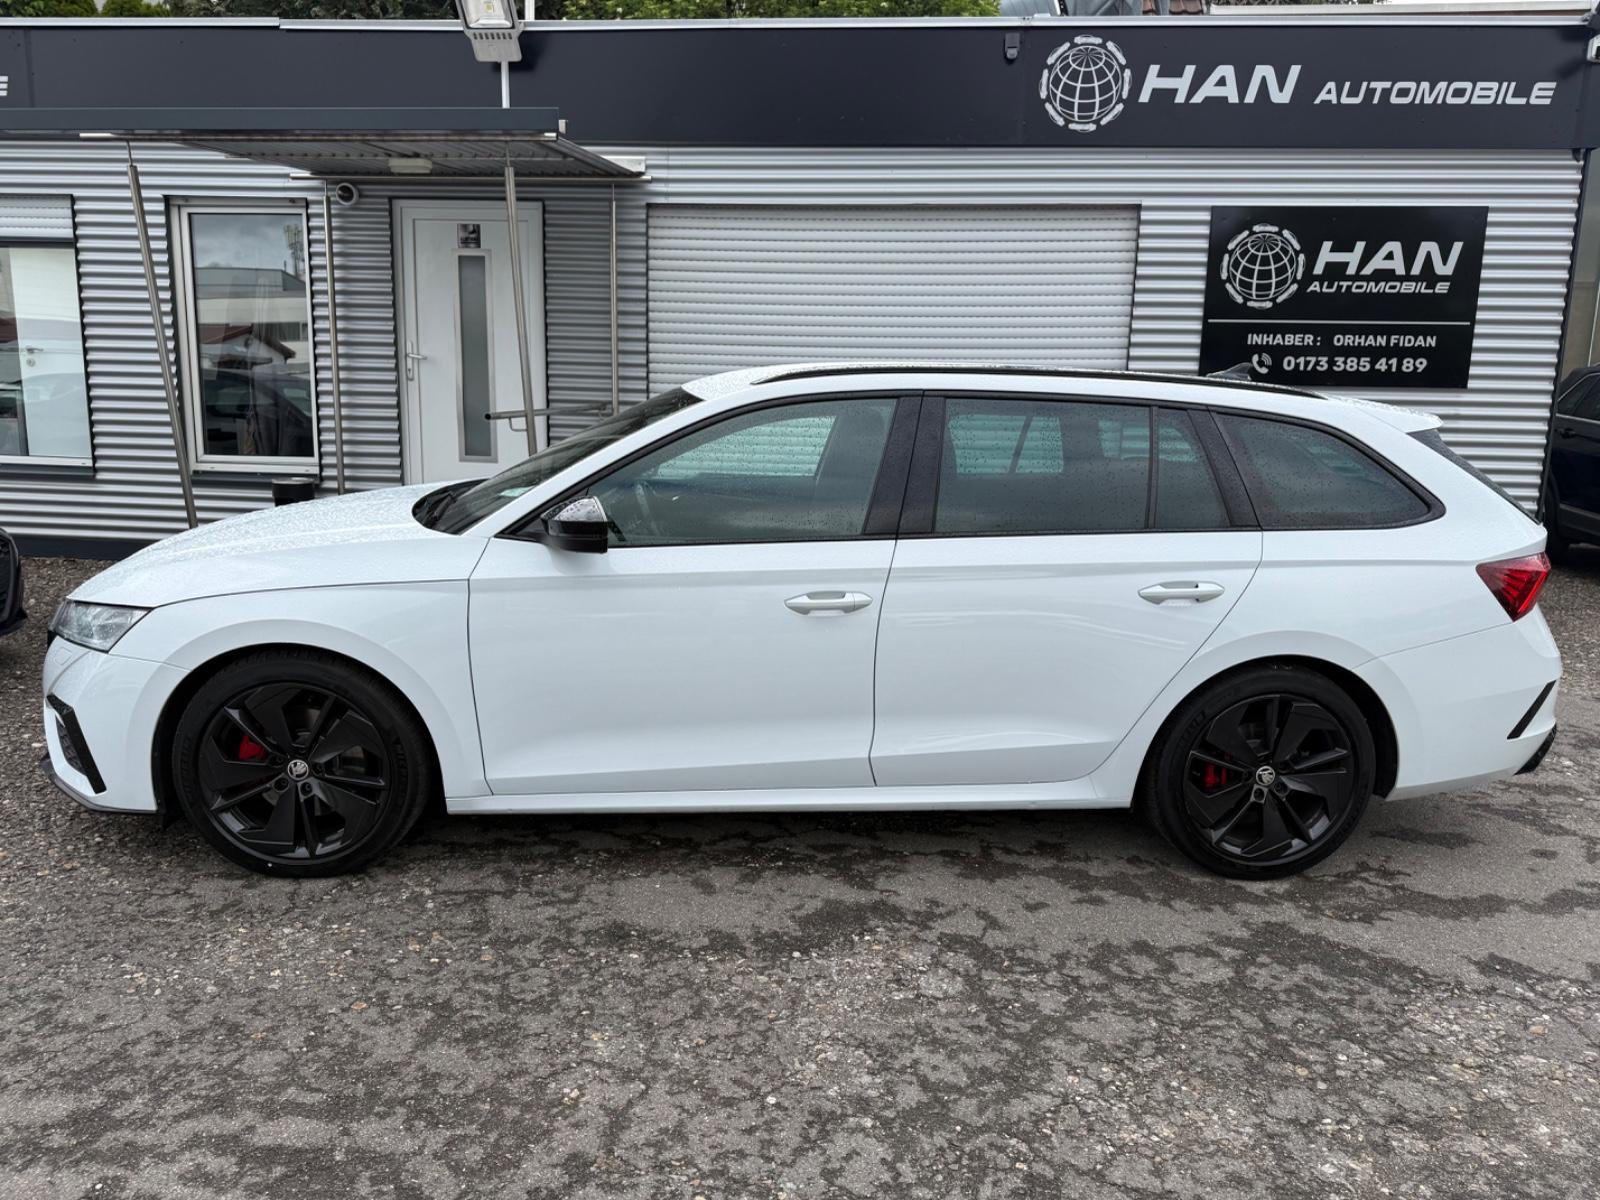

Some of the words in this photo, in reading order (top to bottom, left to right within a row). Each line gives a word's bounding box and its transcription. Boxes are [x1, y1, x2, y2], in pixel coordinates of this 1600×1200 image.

[1138, 64, 1302, 104] HAN
[1313, 81, 1558, 105] AUTOMOBILE
[1312, 240, 1464, 276] HAN
[1306, 281, 1451, 294] AUTOMOBILE
[1333, 334, 1387, 347] ORHAN
[1389, 335, 1437, 347] FIDAN
[1282, 355, 1329, 372] 0173
[1332, 356, 1371, 372] 385
[1374, 357, 1398, 373] 41
[1401, 357, 1428, 373] 89
